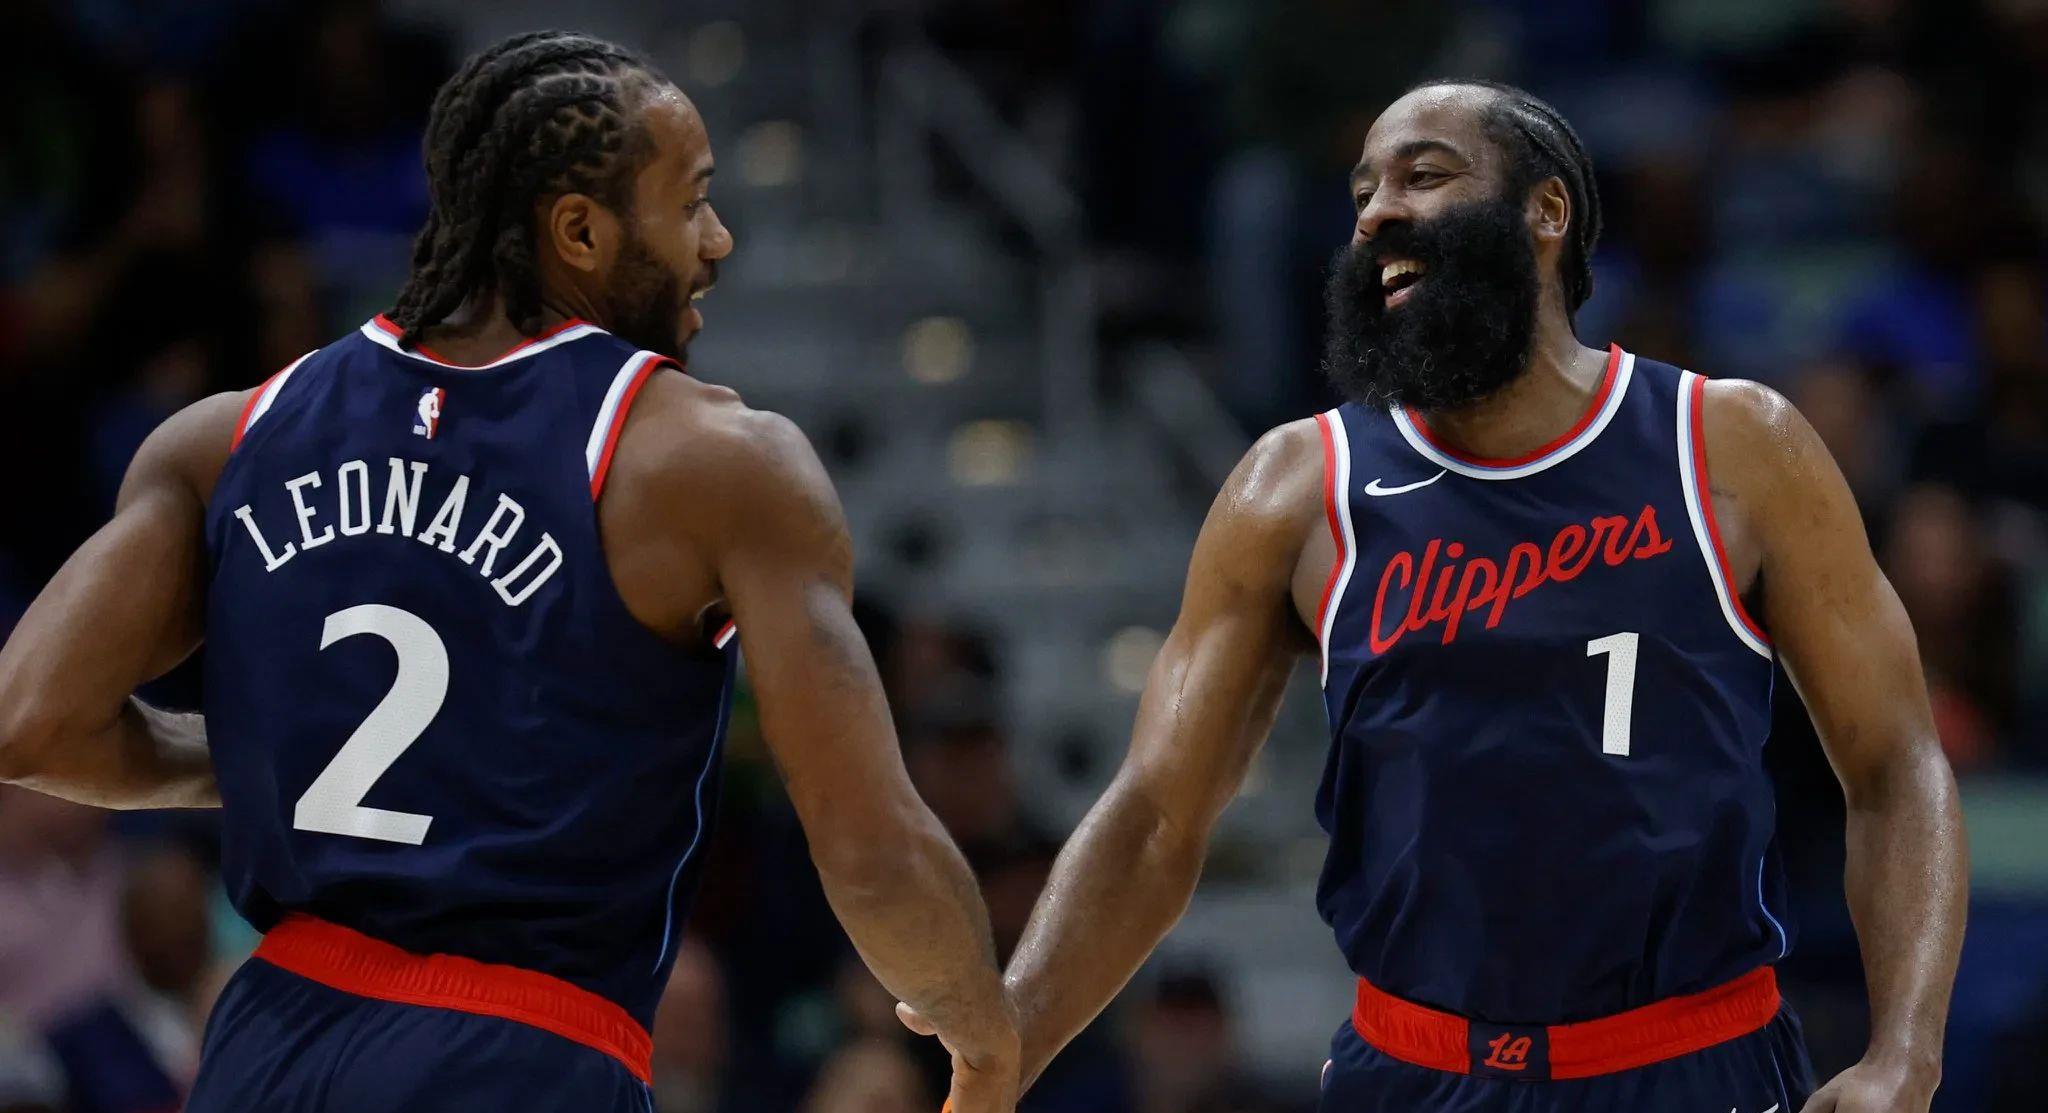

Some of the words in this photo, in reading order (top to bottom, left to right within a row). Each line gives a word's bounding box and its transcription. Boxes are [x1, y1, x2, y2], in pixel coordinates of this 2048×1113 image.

[234, 457, 563, 607] LEONARD
[1369, 504, 1673, 655] Clippers
[293, 603, 450, 846] 2
[1586, 631, 1640, 757] 1
[1483, 1031, 1533, 1071] LA
